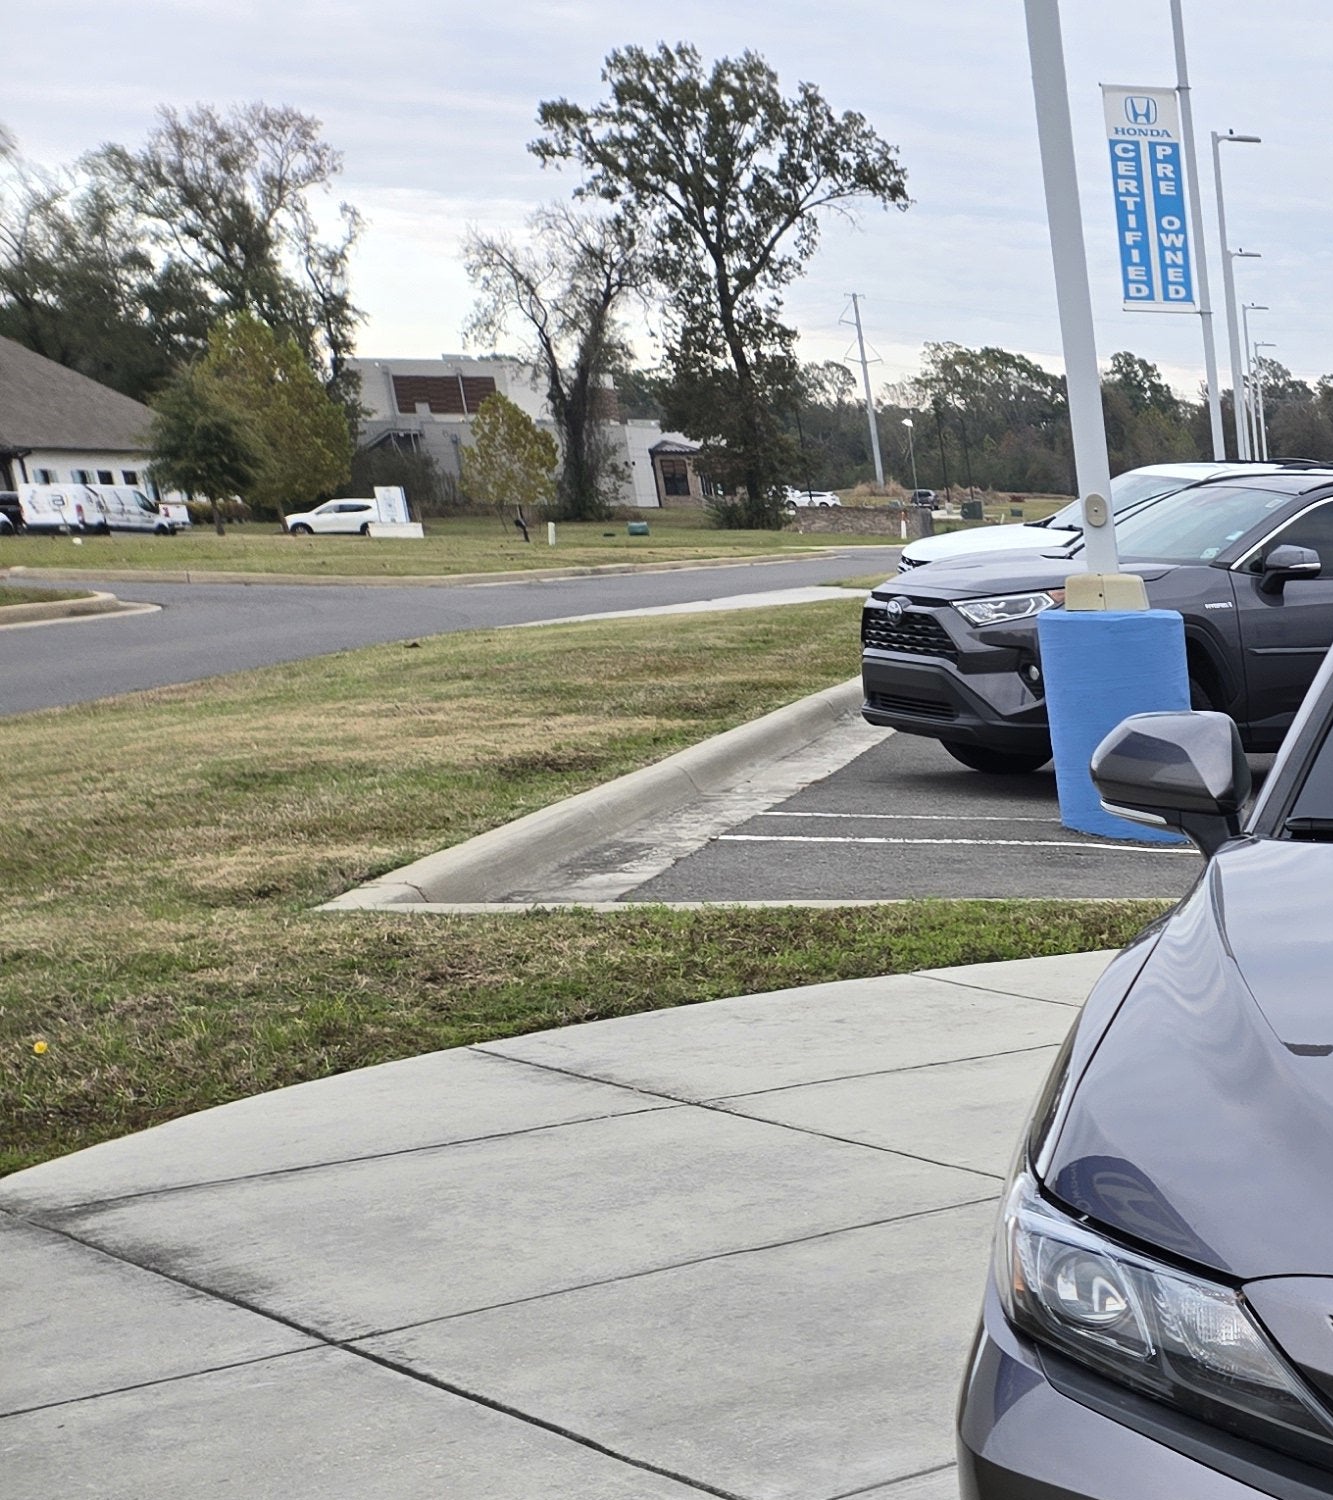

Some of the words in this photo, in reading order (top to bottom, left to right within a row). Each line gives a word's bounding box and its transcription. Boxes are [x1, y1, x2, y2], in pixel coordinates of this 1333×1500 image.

[1113, 126, 1172, 138] HONDA
[1155, 145, 1176, 195] PRE
[1114, 143, 1149, 298] CERTIFIED
[1160, 216, 1187, 299] OWNED
